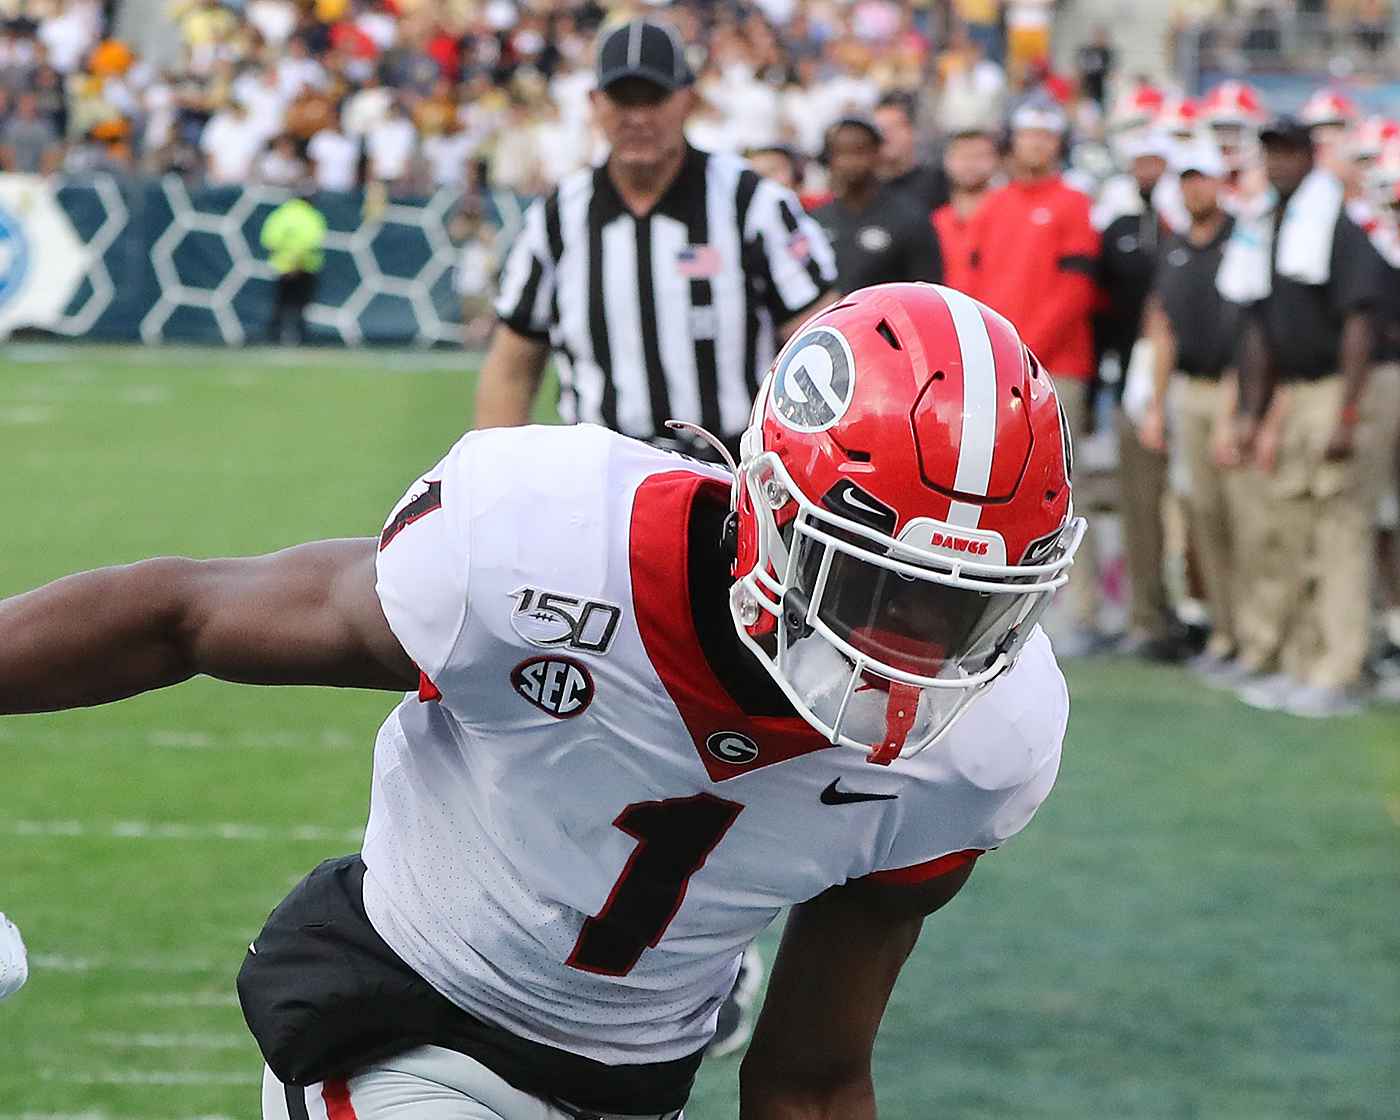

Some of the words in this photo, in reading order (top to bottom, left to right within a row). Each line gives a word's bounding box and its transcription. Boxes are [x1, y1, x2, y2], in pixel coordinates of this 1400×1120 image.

[931, 532, 989, 555] DAWGS
[514, 588, 621, 653] 150
[520, 660, 587, 714] SEC
[564, 791, 746, 977] 1
